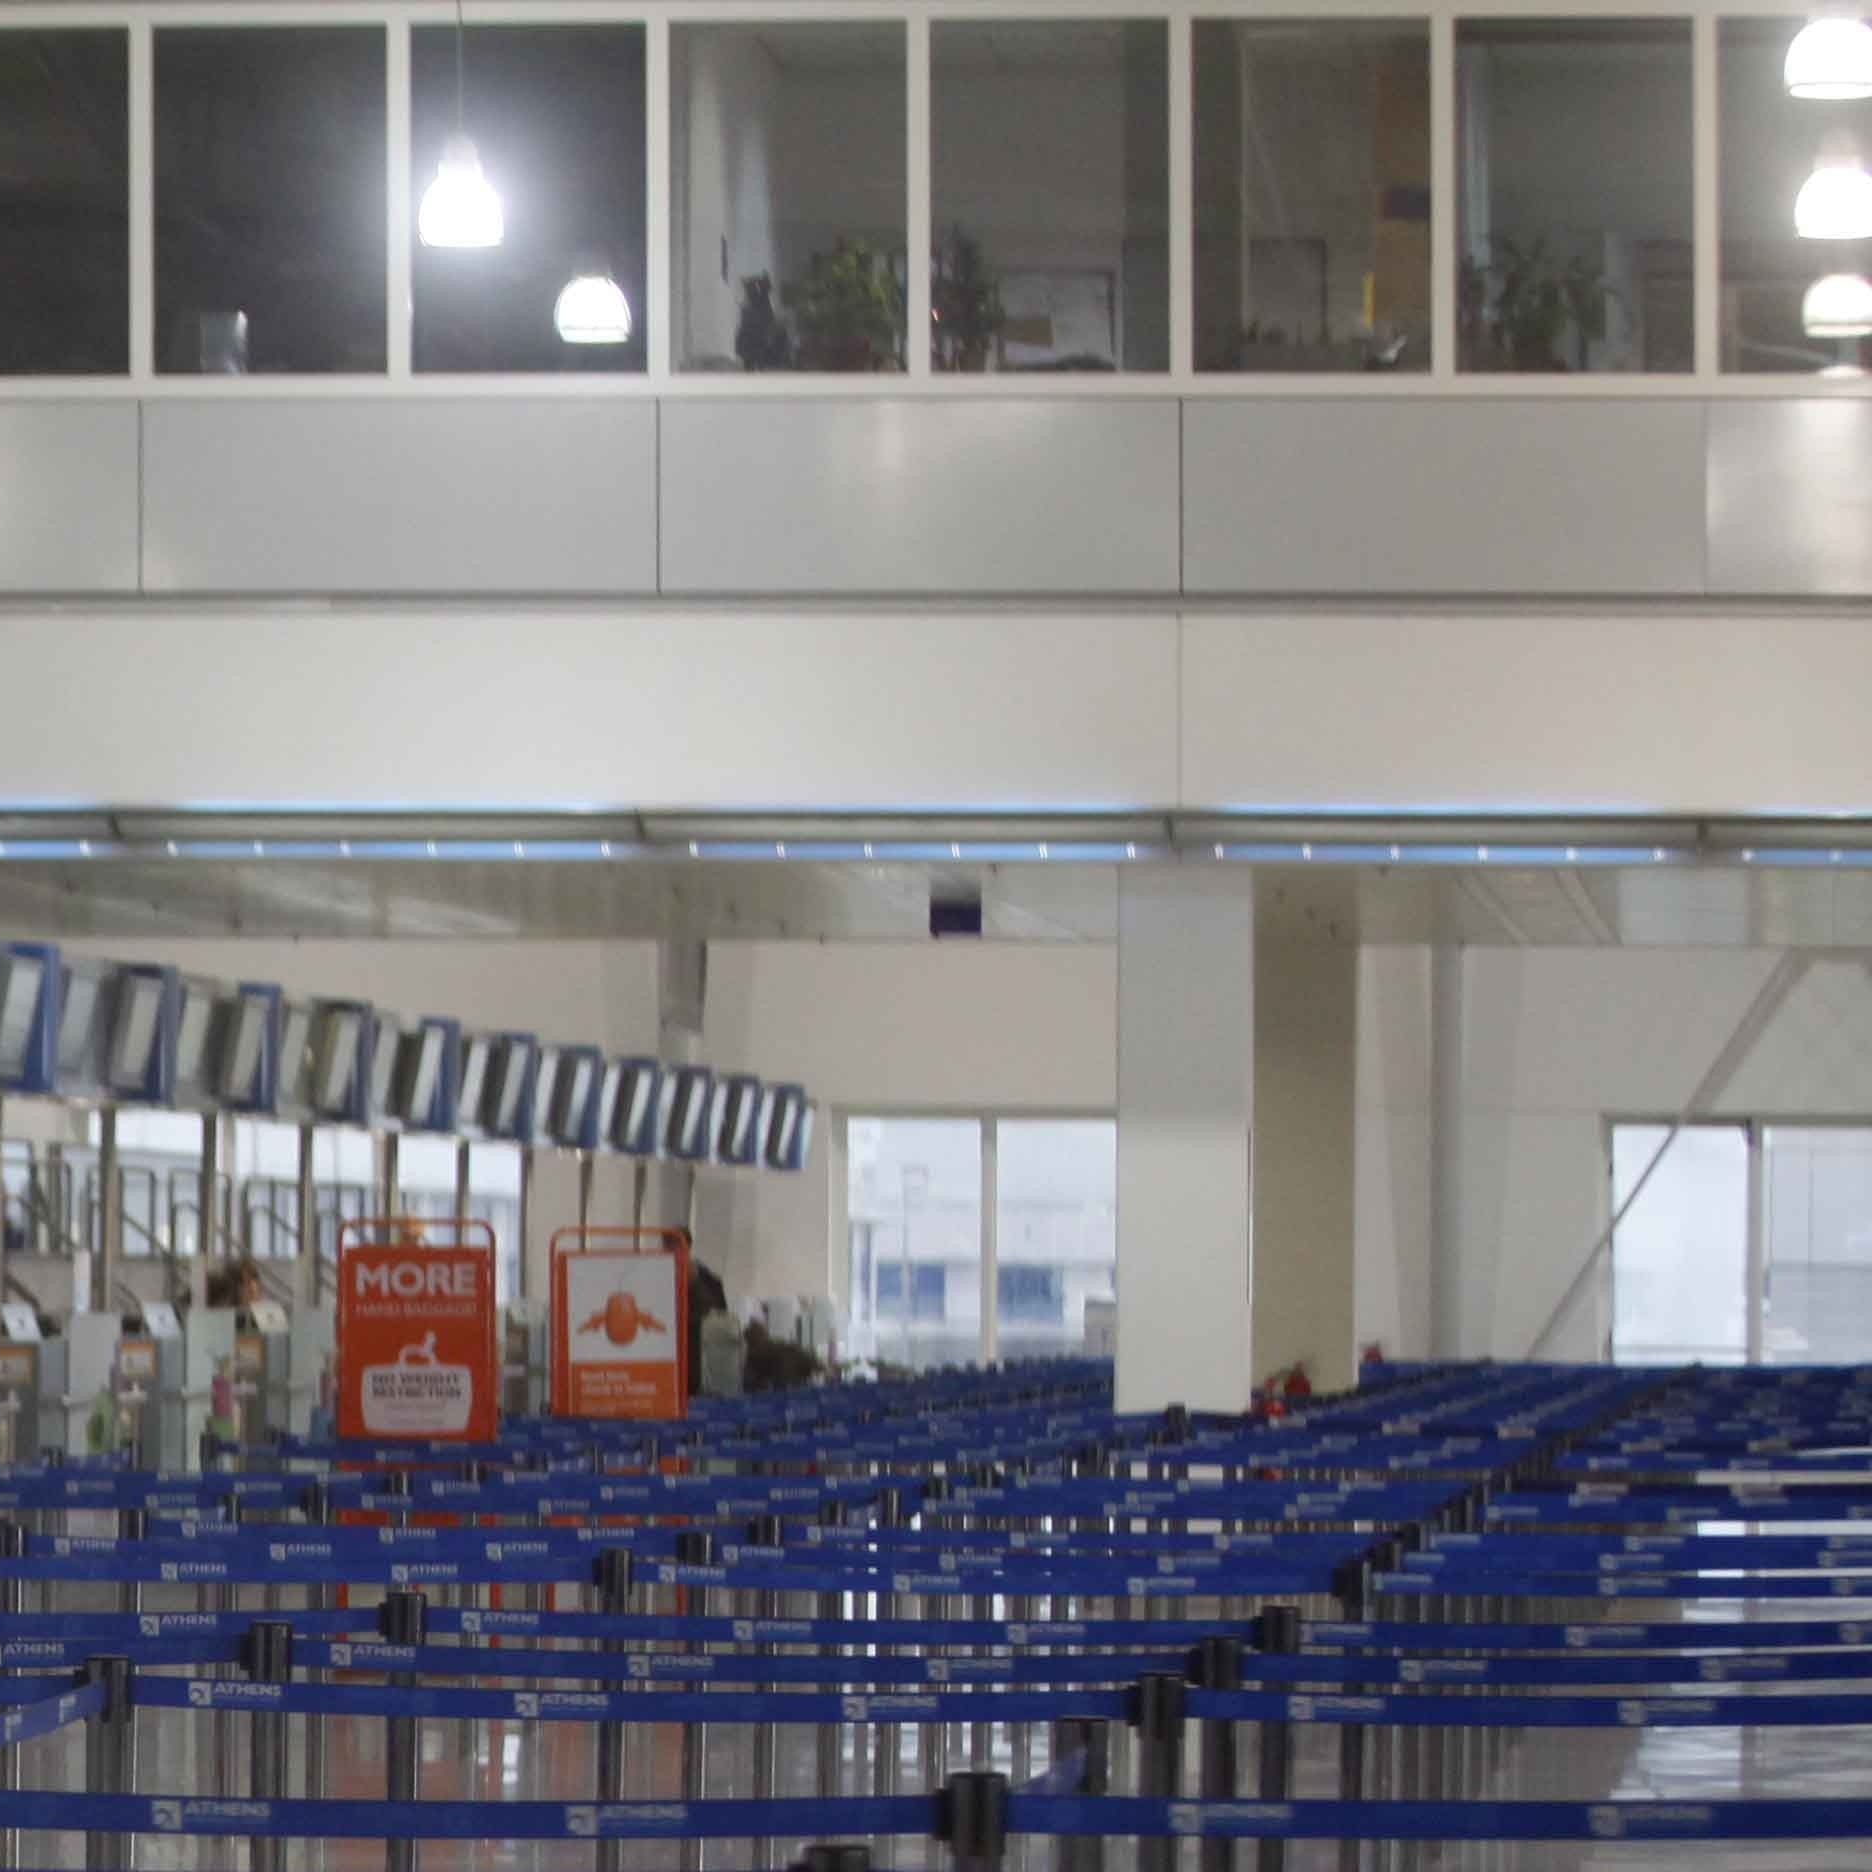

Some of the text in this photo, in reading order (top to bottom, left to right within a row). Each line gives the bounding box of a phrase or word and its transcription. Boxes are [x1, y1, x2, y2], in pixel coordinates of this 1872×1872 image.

[356, 1261, 477, 1298] MORE
[161, 1615, 217, 1626] ATHENS
[4, 1643, 64, 1656] ATHENS
[354, 1647, 416, 1658] ATHENS
[213, 1684, 283, 1697] ATHENS
[541, 1694, 608, 1707] ATHENS
